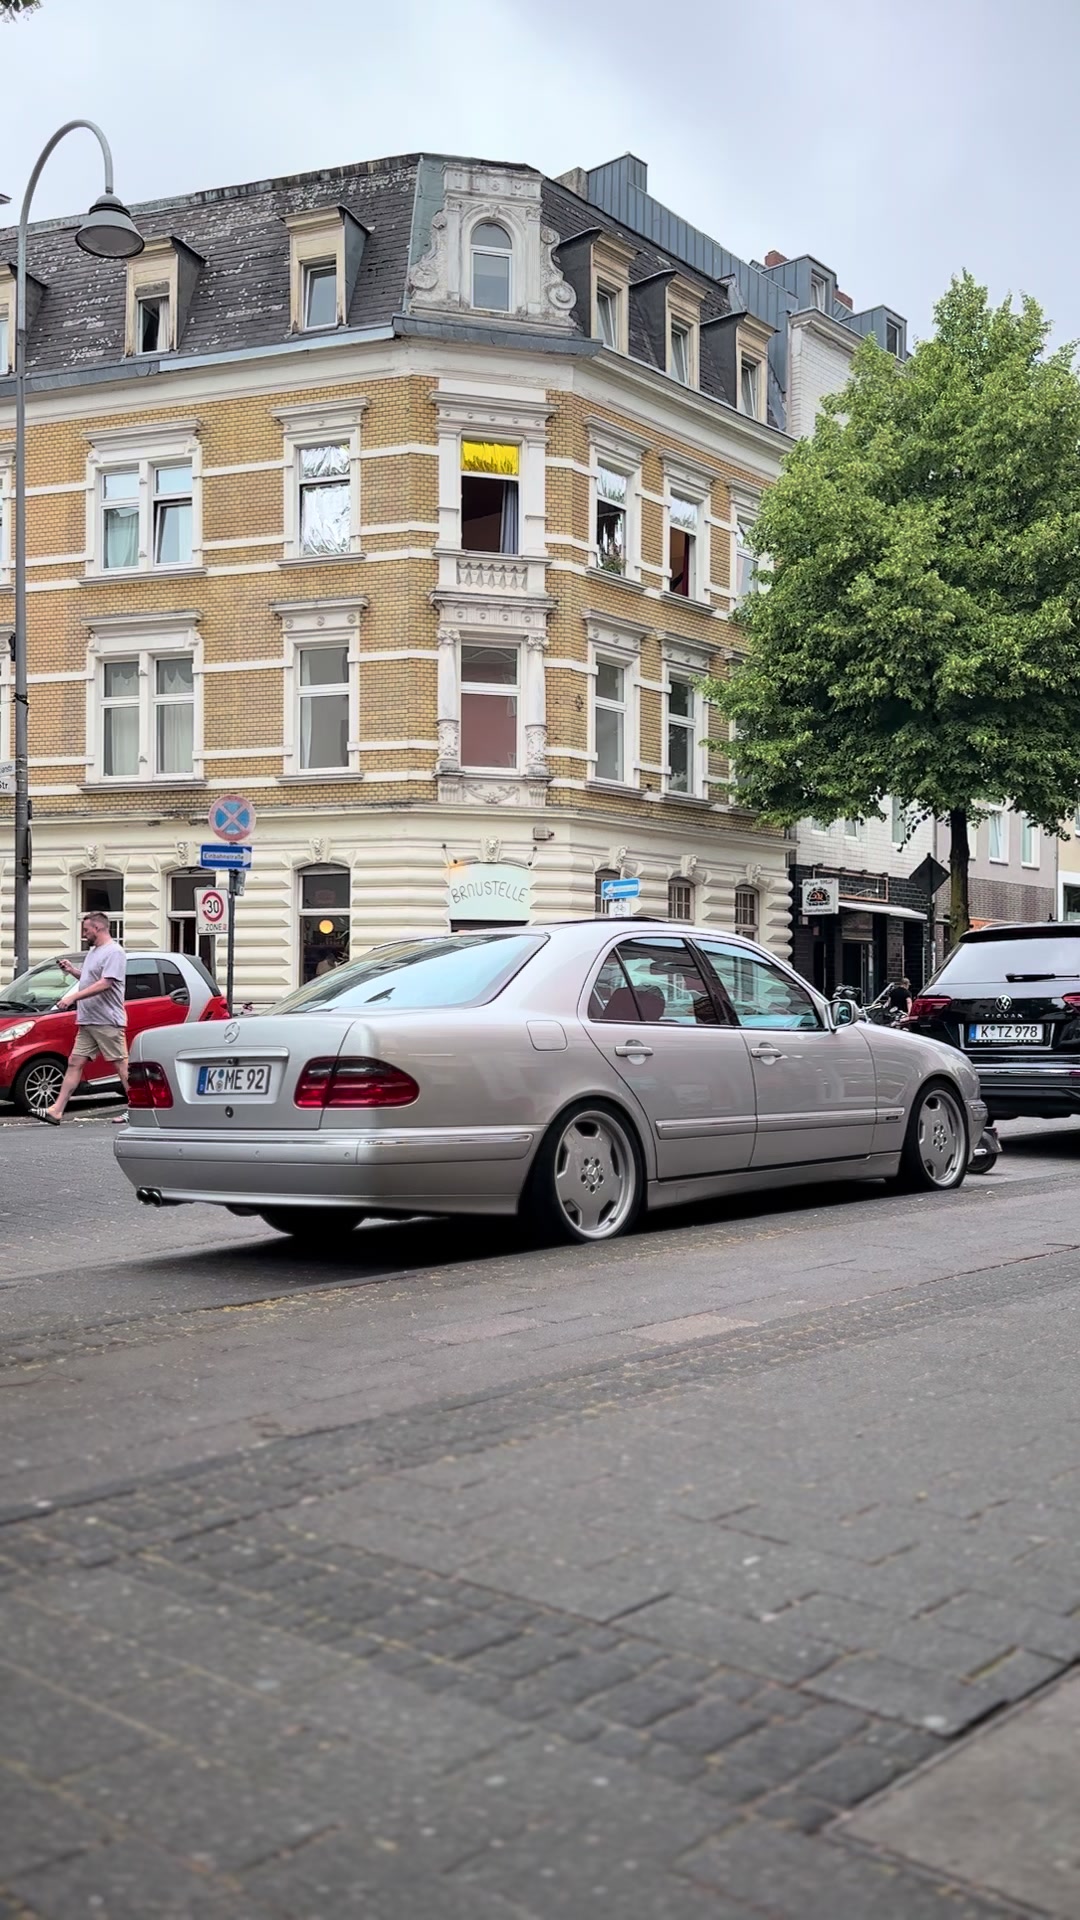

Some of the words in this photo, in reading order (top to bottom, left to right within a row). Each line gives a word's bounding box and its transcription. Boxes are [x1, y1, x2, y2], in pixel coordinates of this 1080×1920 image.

[206, 899, 220, 914] 30
[205, 923, 222, 931] ZONE
[980, 1025, 989, 1038] K
[997, 1025, 1014, 1038] TZ
[1015, 1025, 1038, 1038] 978
[206, 1069, 217, 1091] K
[224, 1069, 244, 1090] ME
[247, 1068, 265, 1090] 92
